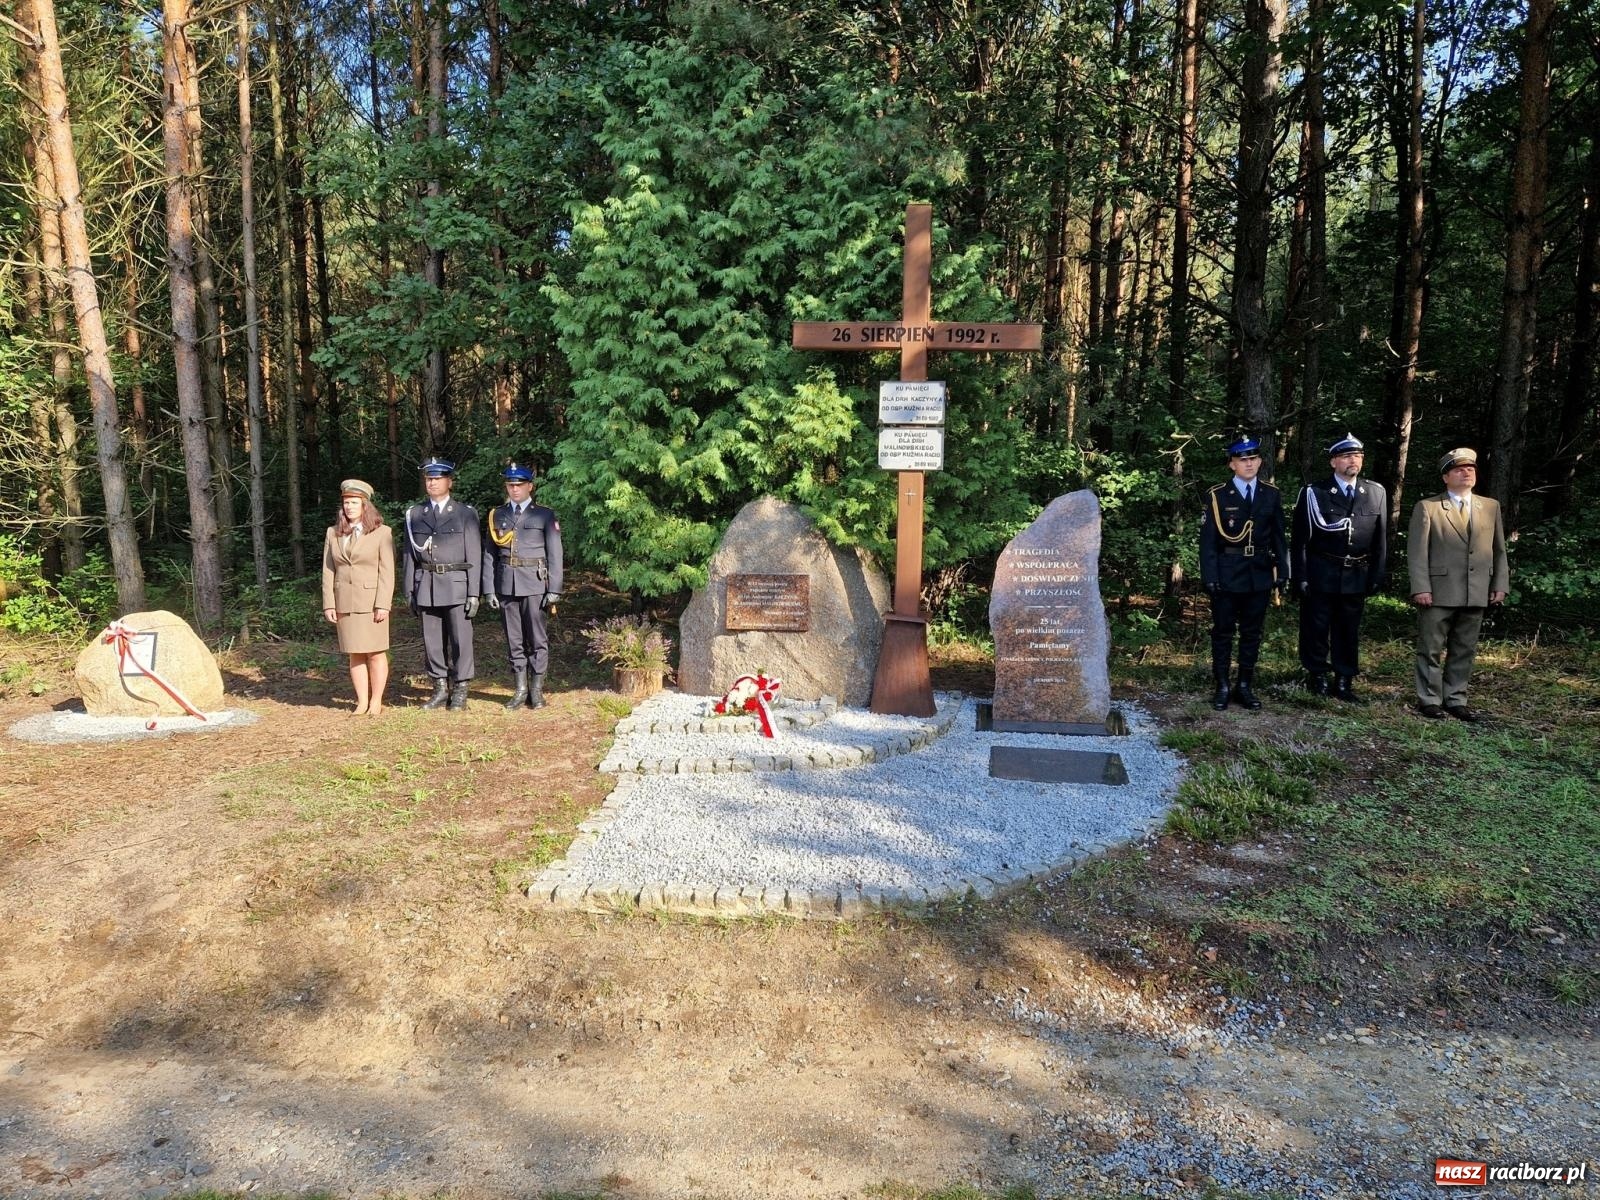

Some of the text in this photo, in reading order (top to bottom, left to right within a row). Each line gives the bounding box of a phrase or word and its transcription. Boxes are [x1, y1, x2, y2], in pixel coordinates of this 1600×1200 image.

[832, 326, 1000, 343] 26 SIERPIEŃ 1992 r.
[1013, 548, 1061, 556] TRAGEDIA
[1016, 560, 1080, 569] WSPÓŁPRACA
[1029, 642, 1071, 650] Pamiętamy
